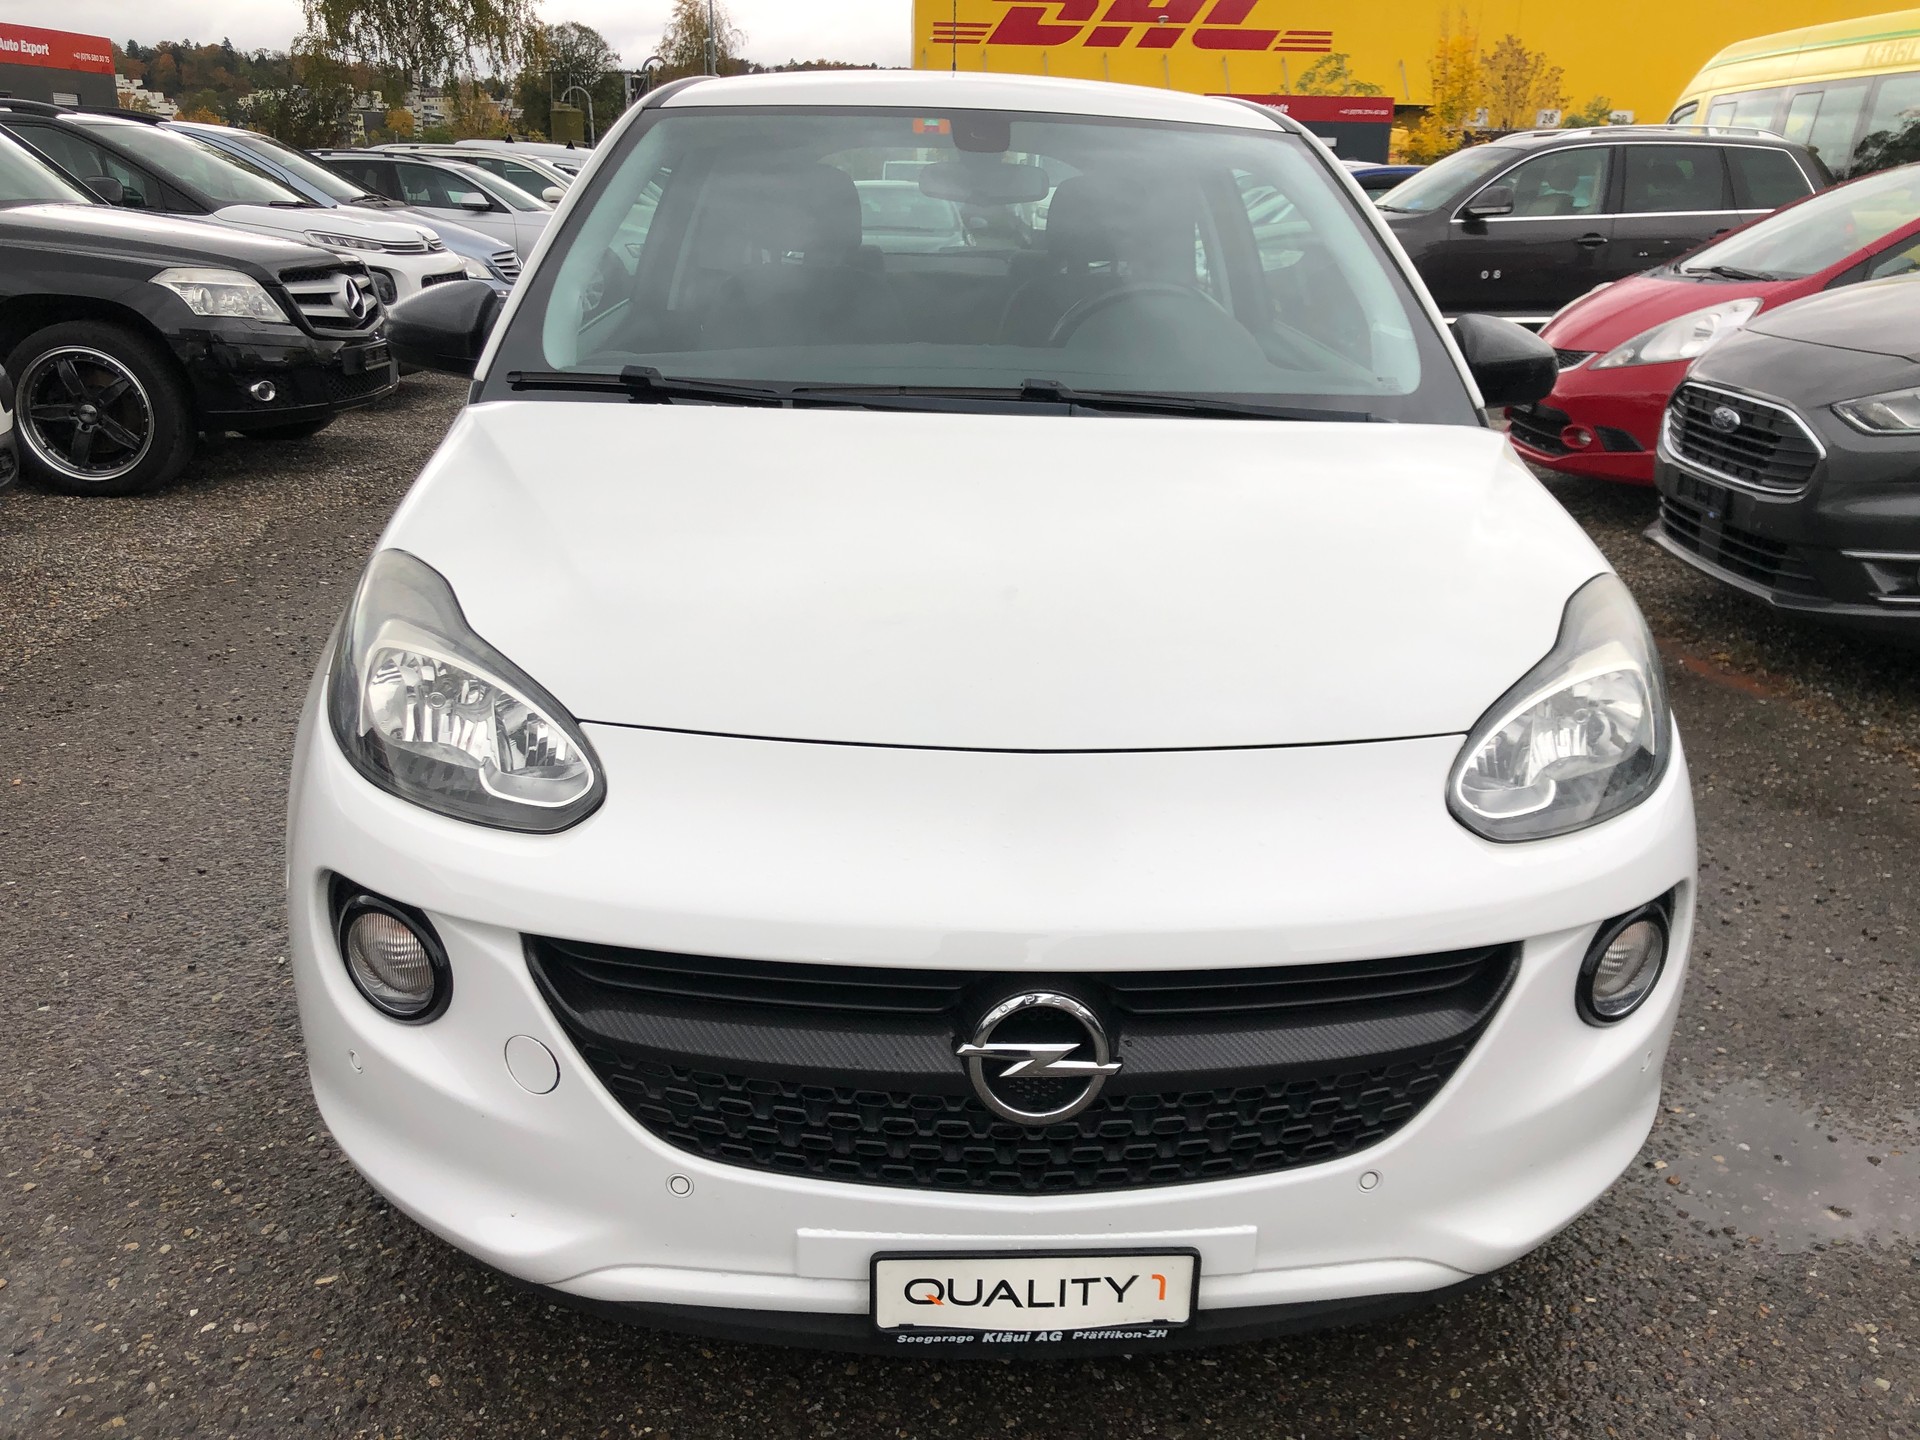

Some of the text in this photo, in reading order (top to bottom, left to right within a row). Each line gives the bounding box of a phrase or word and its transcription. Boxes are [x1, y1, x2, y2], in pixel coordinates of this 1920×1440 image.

[985, 0, 1280, 51] DHL
[20, 39, 49, 56] Export
[1000, 994, 1084, 1017] OPEL
[904, 1275, 1139, 1308] QUALITY
[896, 1329, 1168, 1344] Seegarage Kläui AG Pfäffikon-ZH
